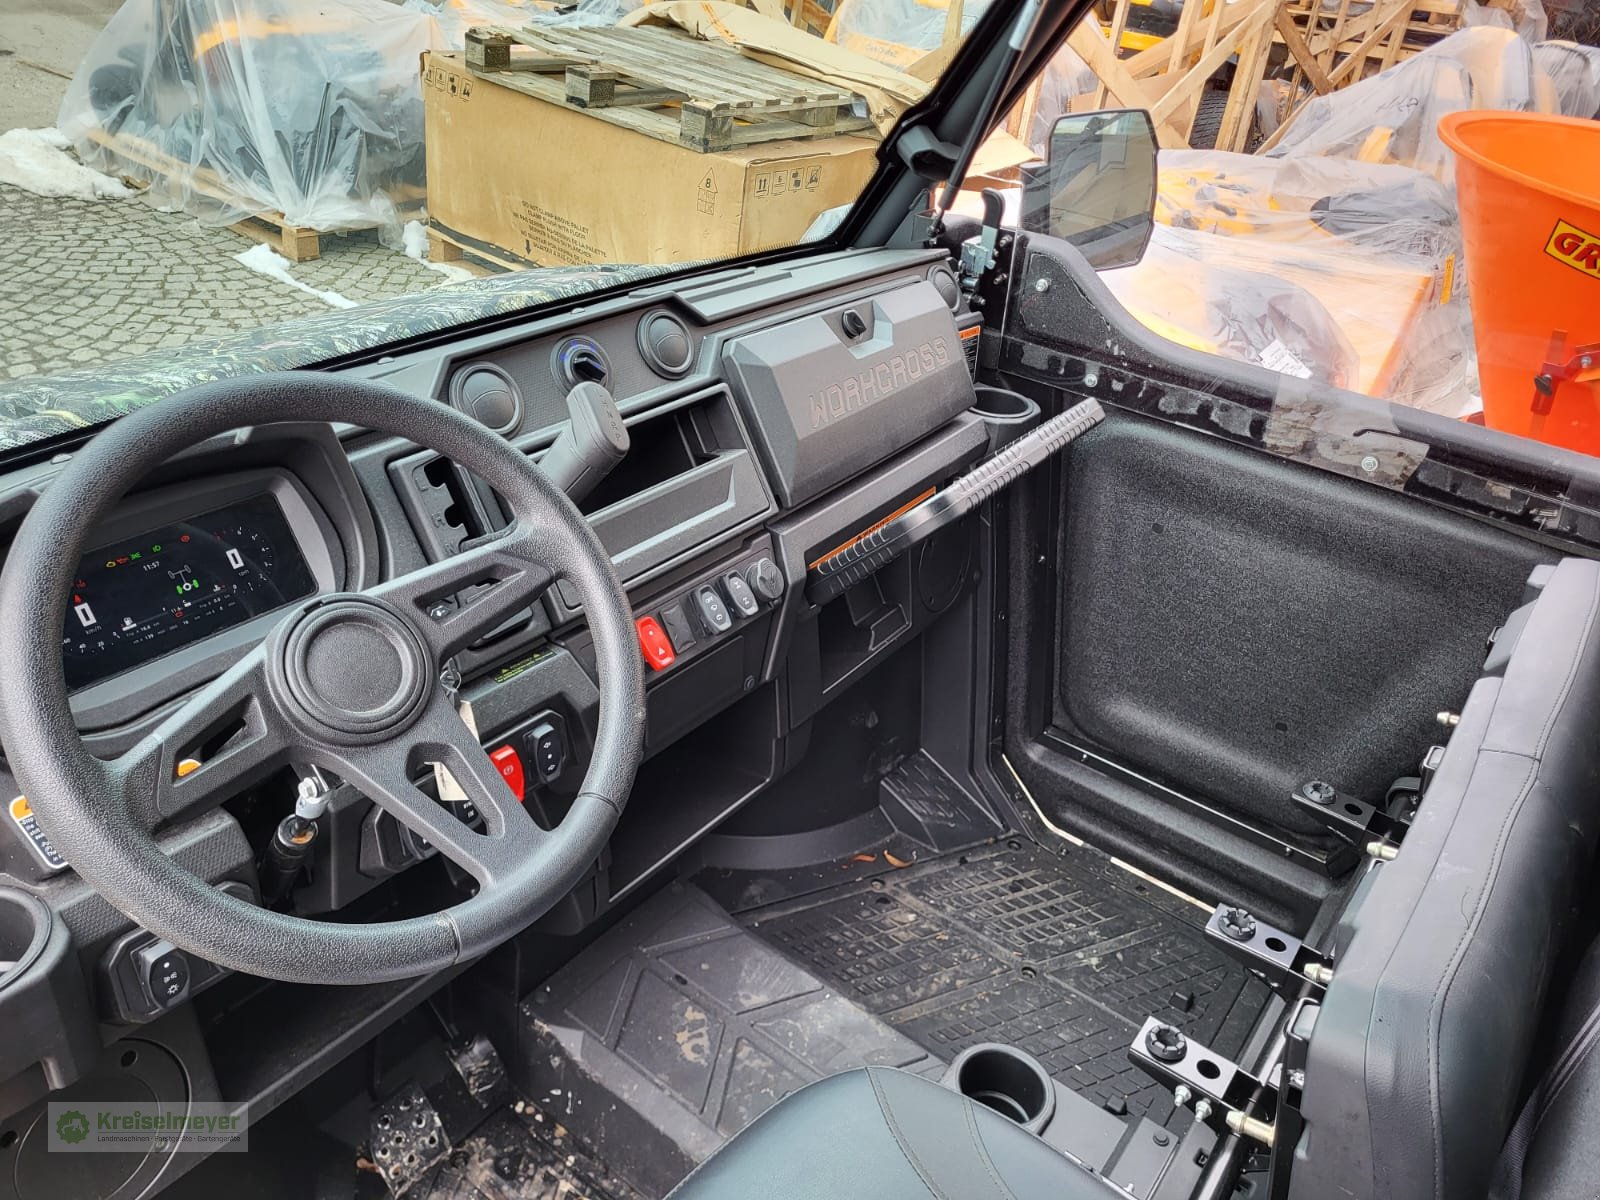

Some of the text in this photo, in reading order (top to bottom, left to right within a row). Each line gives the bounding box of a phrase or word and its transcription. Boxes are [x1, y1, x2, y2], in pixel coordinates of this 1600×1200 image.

[705, 177, 711, 188] 8
[1554, 232, 1600, 273] GR
[809, 336, 950, 429] WORKCROSS
[225, 547, 245, 570] 0
[73, 602, 97, 627] 0
